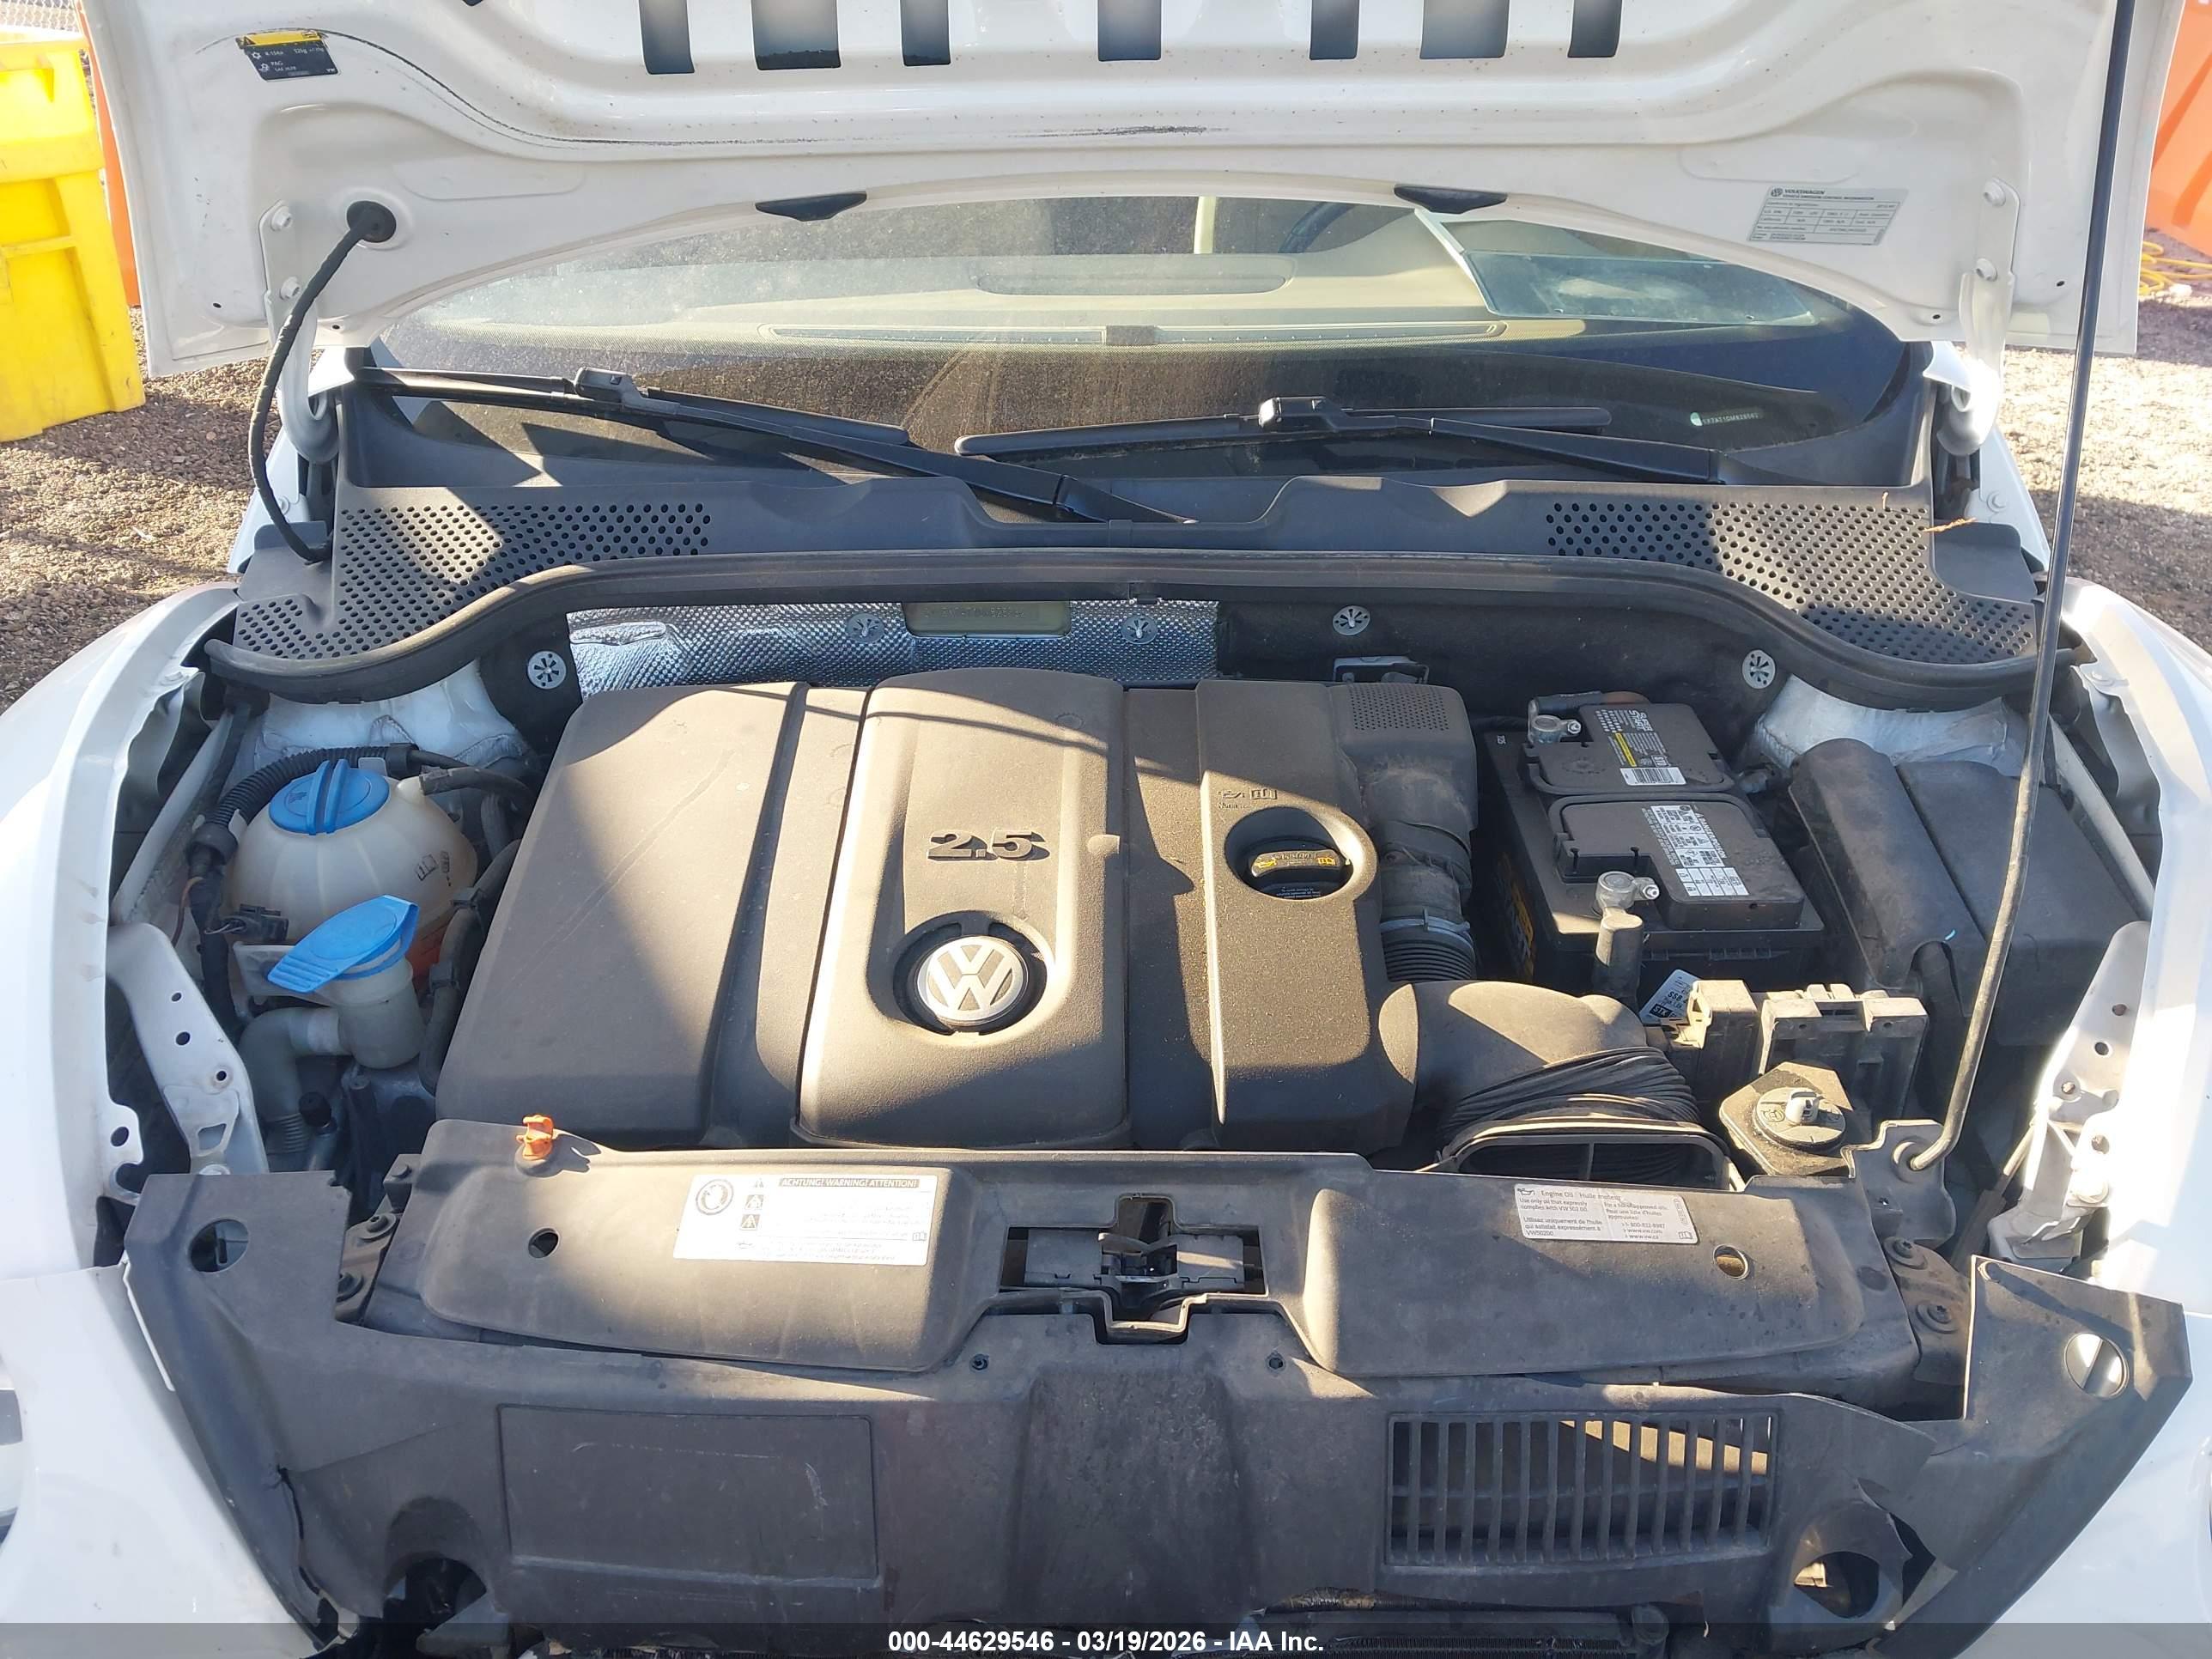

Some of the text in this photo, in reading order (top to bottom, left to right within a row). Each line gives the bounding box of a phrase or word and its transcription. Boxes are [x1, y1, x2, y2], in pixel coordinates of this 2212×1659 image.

[927, 829, 1050, 861] 2.5
[921, 939, 1021, 1018] VW
[781, 1178, 917, 1188] ACHTUNG! WARNING! ATTENTION!
